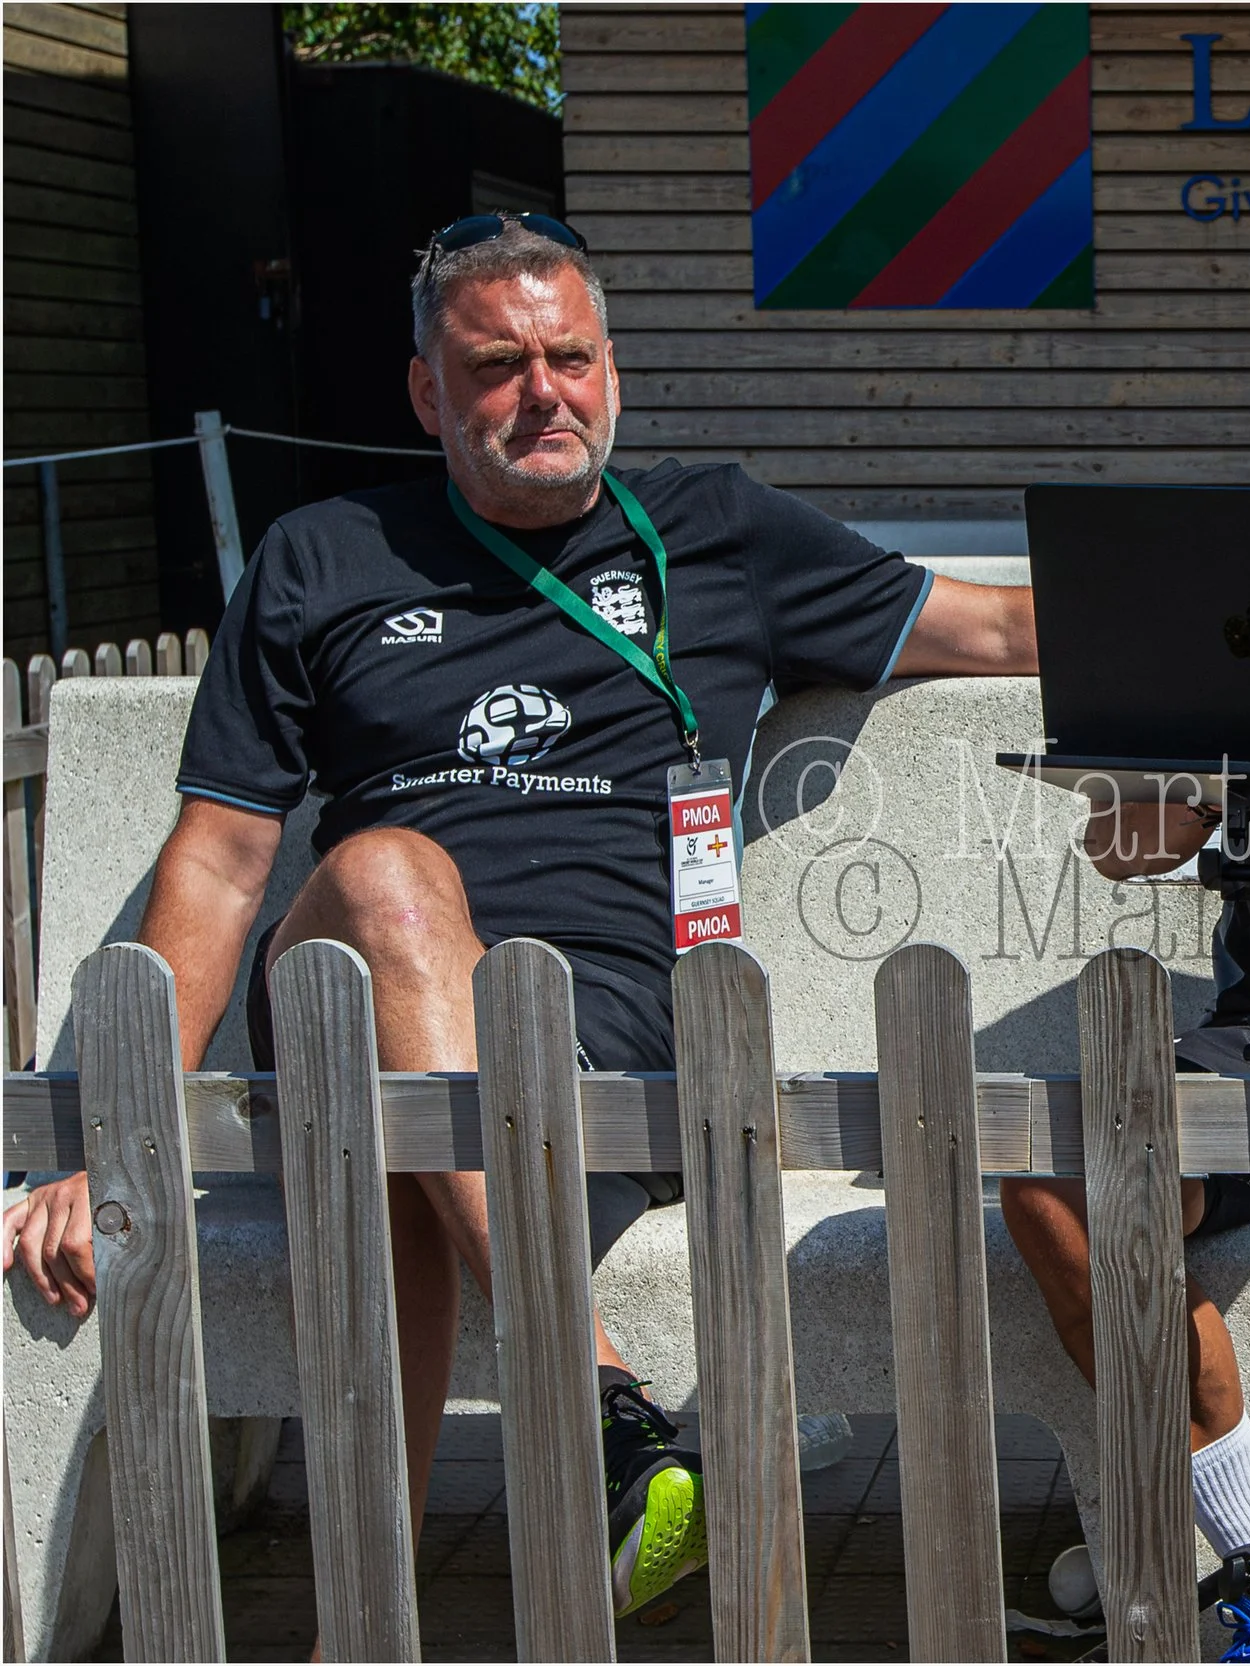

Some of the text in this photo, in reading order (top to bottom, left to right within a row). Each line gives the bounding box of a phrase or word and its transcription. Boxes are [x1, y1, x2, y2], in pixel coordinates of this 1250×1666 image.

[590, 570, 643, 586] GUERNSEY
[381, 634, 444, 645] MASURI
[391, 765, 612, 795] Smarter Payments
[682, 804, 721, 828] PMOA
[688, 914, 731, 940] PMOA
